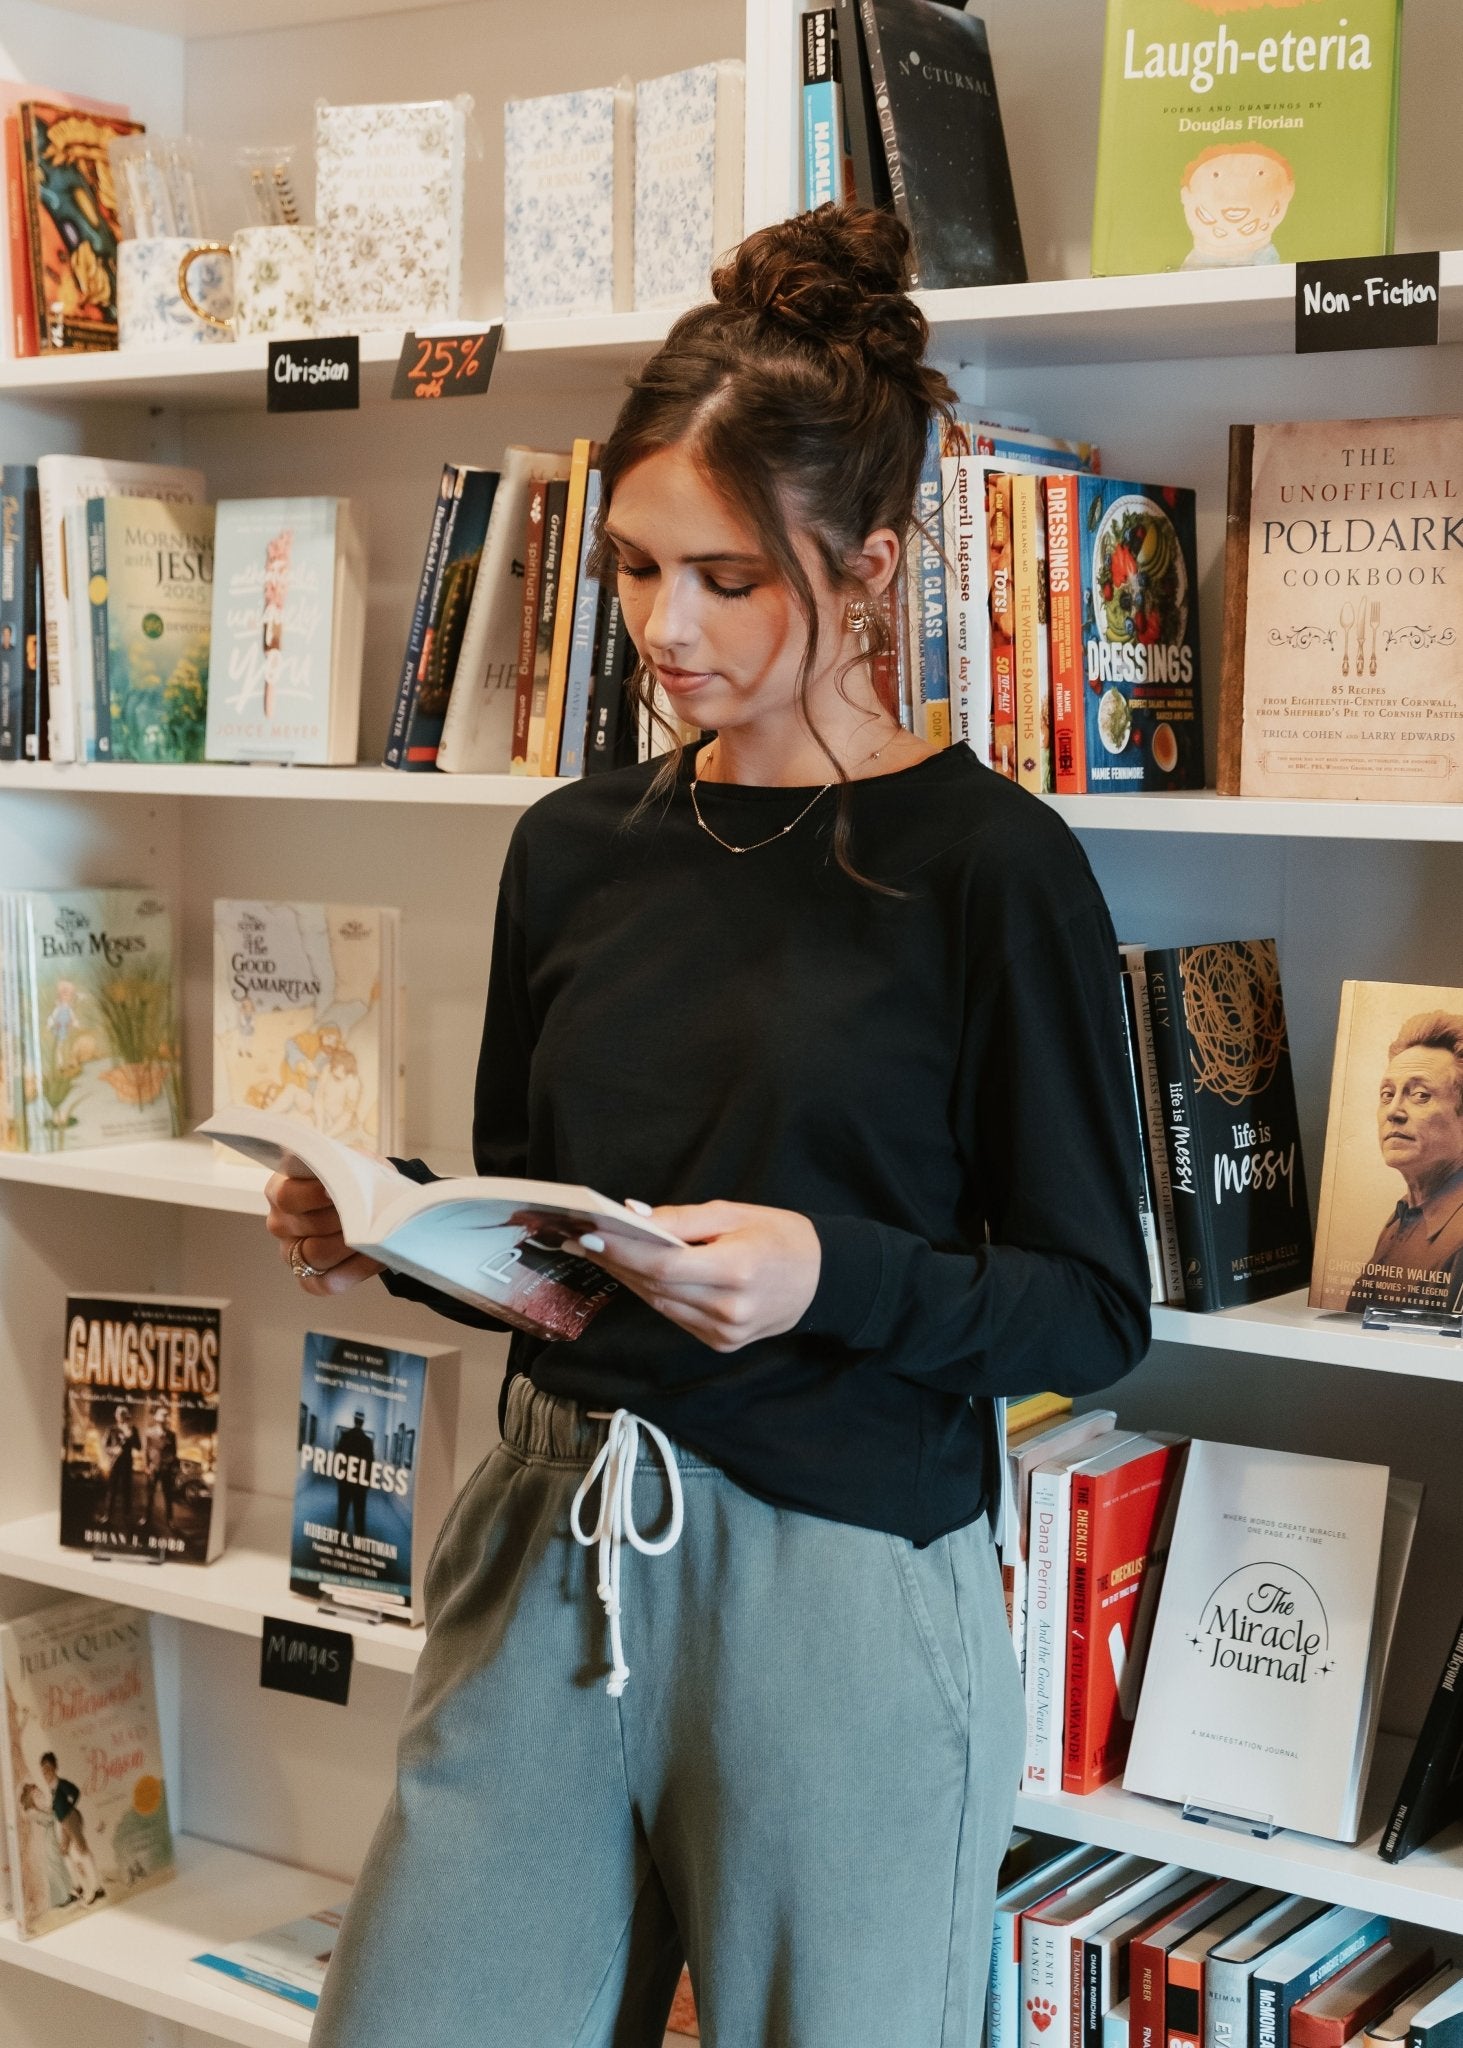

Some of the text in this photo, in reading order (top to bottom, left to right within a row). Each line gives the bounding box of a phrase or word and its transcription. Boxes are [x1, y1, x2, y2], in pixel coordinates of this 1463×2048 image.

[814, 13, 827, 77] NO FEAR
[1123, 18, 1372, 94] Laugh-eteria
[1163, 102, 1324, 115] POEMS AND DRAWINGS BY
[1178, 114, 1304, 134] Douglas Florian
[814, 120, 831, 206] HAMLE
[1303, 277, 1437, 316] Non-Fiction
[274, 353, 350, 384] Christian
[407, 334, 485, 379] 25%
[1341, 446, 1396, 468] THE
[1020, 490, 1028, 530] JENNIFER
[1279, 479, 1457, 505] UNOFFICIAL
[545, 513, 560, 571] Grieving
[957, 468, 974, 602] emeril lagasse
[1047, 487, 1070, 593] DRESSINGS
[155, 549, 214, 588] JESU
[1022, 560, 1029, 573] MD
[1282, 565, 1448, 588] COOKBOOK
[518, 541, 538, 676] spiritual parenting
[542, 581, 558, 624] Suicide
[924, 572, 944, 639] CLASS
[994, 567, 1009, 614] TOTS!
[574, 595, 595, 652] KATIE
[603, 596, 619, 676] ROBERT MORRIS
[958, 612, 968, 652] every
[959, 655, 972, 694] day's
[1020, 585, 1035, 740] THE WHOLE 9 MONTHS
[1086, 639, 1194, 685] DRESSINGS
[392, 661, 416, 737] JOYCE MEYER
[961, 697, 969, 706] a
[1056, 682, 1064, 721] FENNIMORE
[1063, 689, 1072, 713] MAMIE
[1331, 685, 1344, 695] 85
[516, 693, 527, 739] anthony
[931, 711, 943, 738] COOK
[1262, 729, 1456, 743] TRICIA COHEN LARRY EDWARDS
[1091, 766, 1145, 781] MAMIE FENNIMORE
[231, 952, 277, 974] GOOD
[230, 974, 321, 1003] SAMARITAN
[1152, 972, 1171, 1028] KELLY
[1139, 984, 1159, 1095] SCARED SELFLESS
[1169, 1081, 1182, 1107] life
[1172, 1109, 1183, 1122] is
[1231, 1120, 1272, 1150] life is
[1160, 1169, 1181, 1292] MICHELLE STEVENS
[1328, 1259, 1452, 1285] CHRISTOPHER WALKEN
[1361, 1279, 1449, 1297] THE MOVIES THE LEGEND
[1341, 1289, 1448, 1308] ROBERT SCHNAKENBERG
[68, 1314, 218, 1393] GANGSTERS
[300, 1442, 409, 1497] PRICELESS
[83, 1530, 127, 1548] BRIAN
[147, 1535, 186, 1553] ROBB
[1038, 1512, 1055, 1554] Dana
[1222, 1513, 1248, 1524] WHERE
[1249, 1517, 1276, 1528] WORDS
[1277, 1521, 1308, 1533] CREATE
[1247, 1526, 1263, 1536] ONE
[1264, 1529, 1284, 1539] PAGE
[1286, 1532, 1296, 1540] AT
[1304, 1535, 1323, 1545] TIME
[352, 1535, 398, 1561] WITTMAN
[1072, 1485, 1090, 1623] THE CHECKLIST MANIFESTO
[1036, 1560, 1053, 1611] Perino
[1246, 1582, 1295, 1617] The
[1038, 1618, 1051, 1643] And
[1205, 1604, 1321, 1656] Miracle
[266, 1633, 341, 1673] Mangas
[1038, 1643, 1050, 1663] the
[1071, 1642, 1083, 1685] ATUL
[1209, 1637, 1308, 1684] Journal
[1036, 1666, 1050, 1698] Good
[1035, 1699, 1049, 1731] News
[1068, 1686, 1083, 1763] GAWANDE
[1199, 1731, 1263, 1752] MANIFESTATION
[1264, 1745, 1299, 1760] JOURNAL
[991, 1923, 1002, 2034] A Woman's BODY
[1030, 1936, 1040, 1986] MANCE
[1045, 1939, 1054, 1988] HENRY
[1309, 1935, 1367, 1986] THE STARGATE CHRONICLES
[1072, 1949, 1081, 2029] DREAMING OF THE
[1089, 1953, 1097, 2031] CHAD M. ROBICHAUX
[1142, 1966, 1152, 2002] PREBER
[1208, 1990, 1242, 2004] NEIMAN
